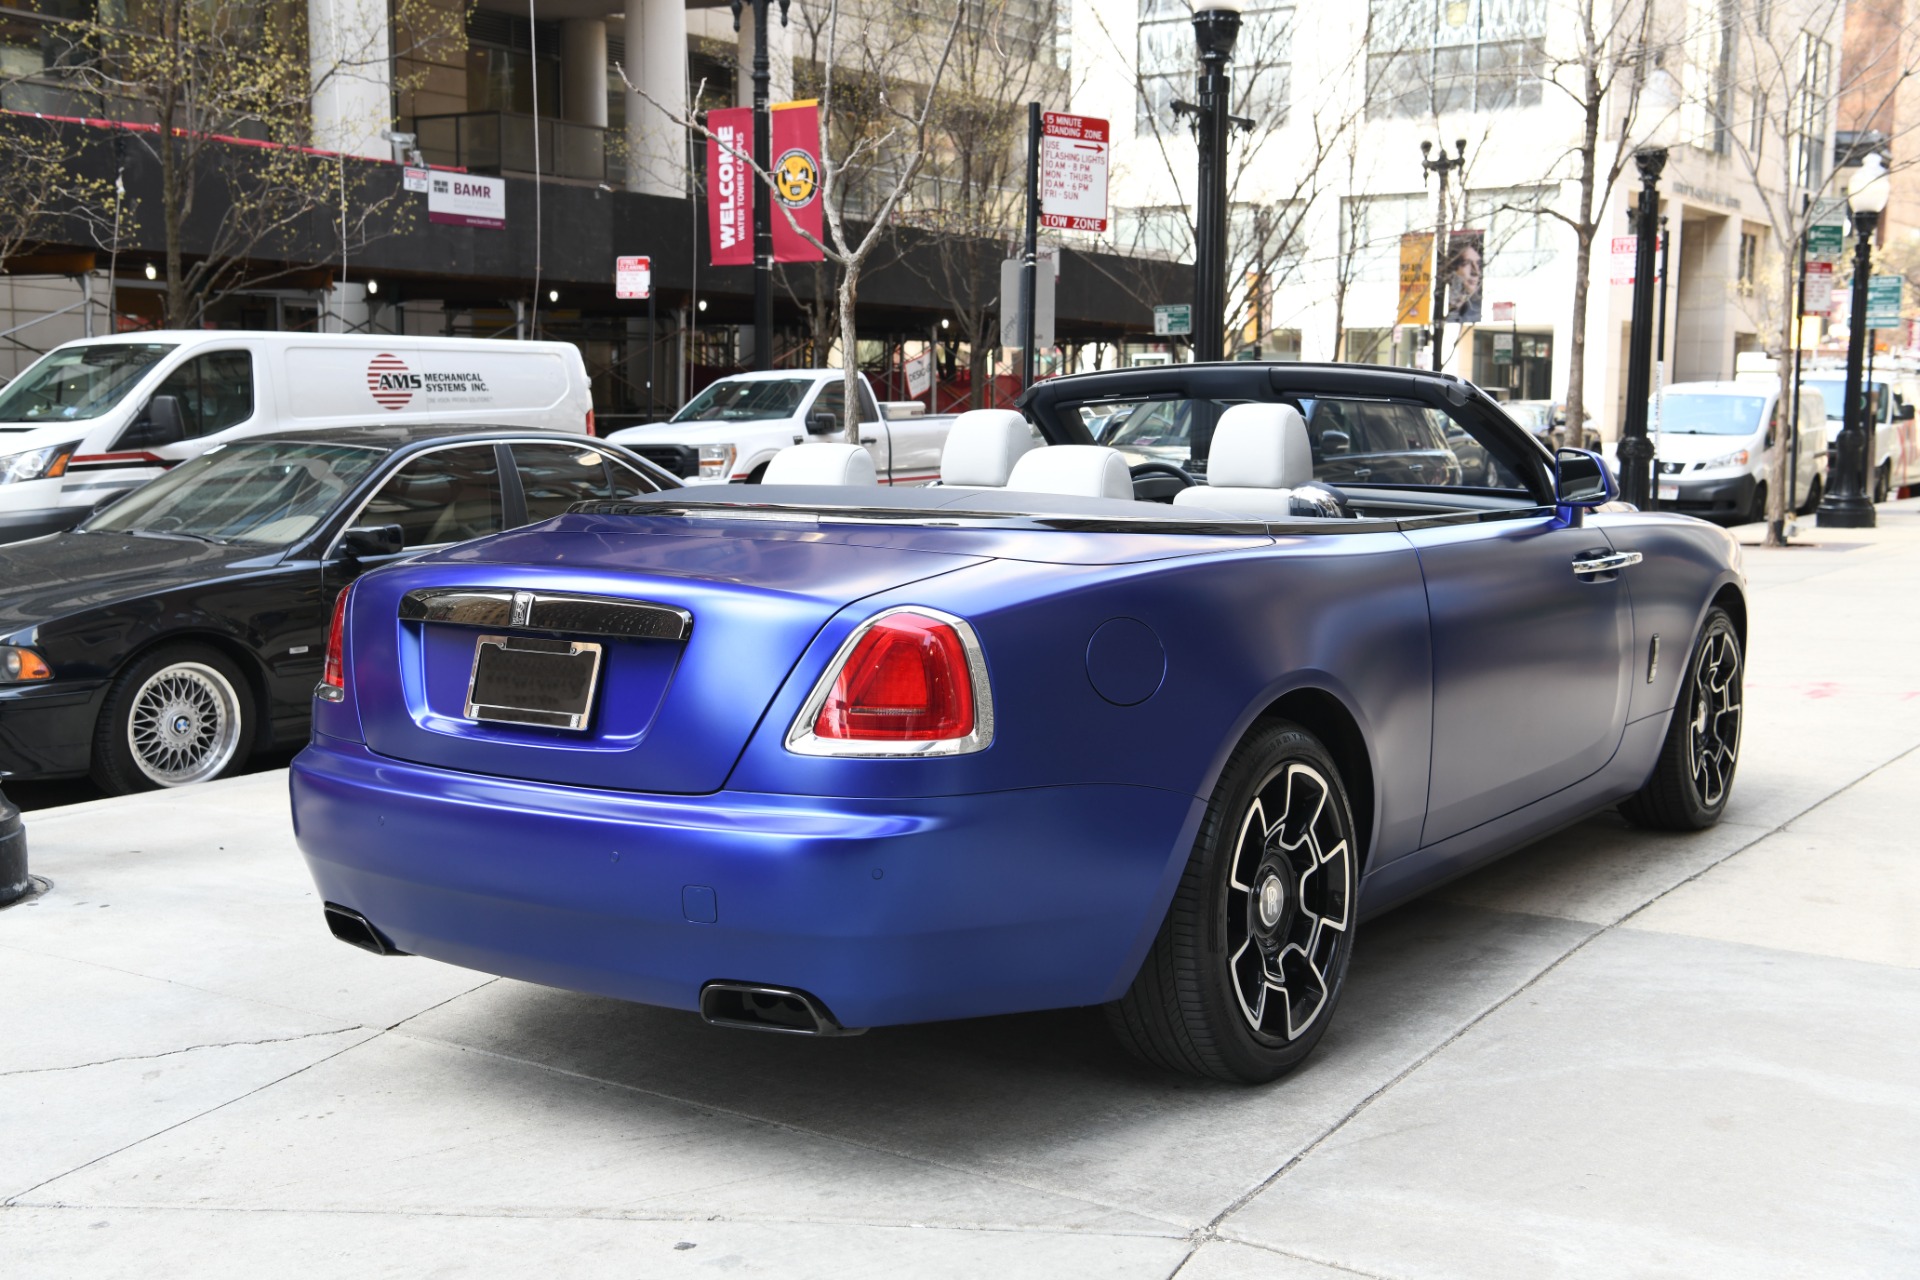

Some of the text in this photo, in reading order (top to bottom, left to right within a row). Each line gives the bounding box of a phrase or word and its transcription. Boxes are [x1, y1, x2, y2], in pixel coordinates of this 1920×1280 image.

[1046, 114, 1082, 128] 15 MINUTE
[1046, 125, 1103, 140] STANDING ZONE
[1045, 140, 1060, 150] USE
[1045, 150, 1105, 165] FLASHING LIGHTS
[1045, 160, 1053, 168] 10
[1055, 161, 1065, 169] AM
[1072, 163, 1077, 171] 8
[1079, 164, 1090, 172] PM
[1045, 170, 1061, 179] MON
[1069, 172, 1093, 183] THURS
[453, 182, 491, 199] BAMR
[717, 126, 736, 250] WELCOME
[736, 174, 744, 207] TOWER
[1045, 179, 1052, 187] 10
[1053, 180, 1064, 188] AM
[1071, 183, 1077, 191] 6
[1078, 183, 1089, 191] PM
[1044, 189, 1057, 198] FRI
[1063, 191, 1079, 200] SUN
[737, 209, 745, 241] WATER
[1044, 215, 1102, 231] TOW ZONE
[379, 374, 422, 389] AMS
[424, 373, 483, 382] MECHANICAL
[426, 383, 490, 392] SYSTEMS INC.
